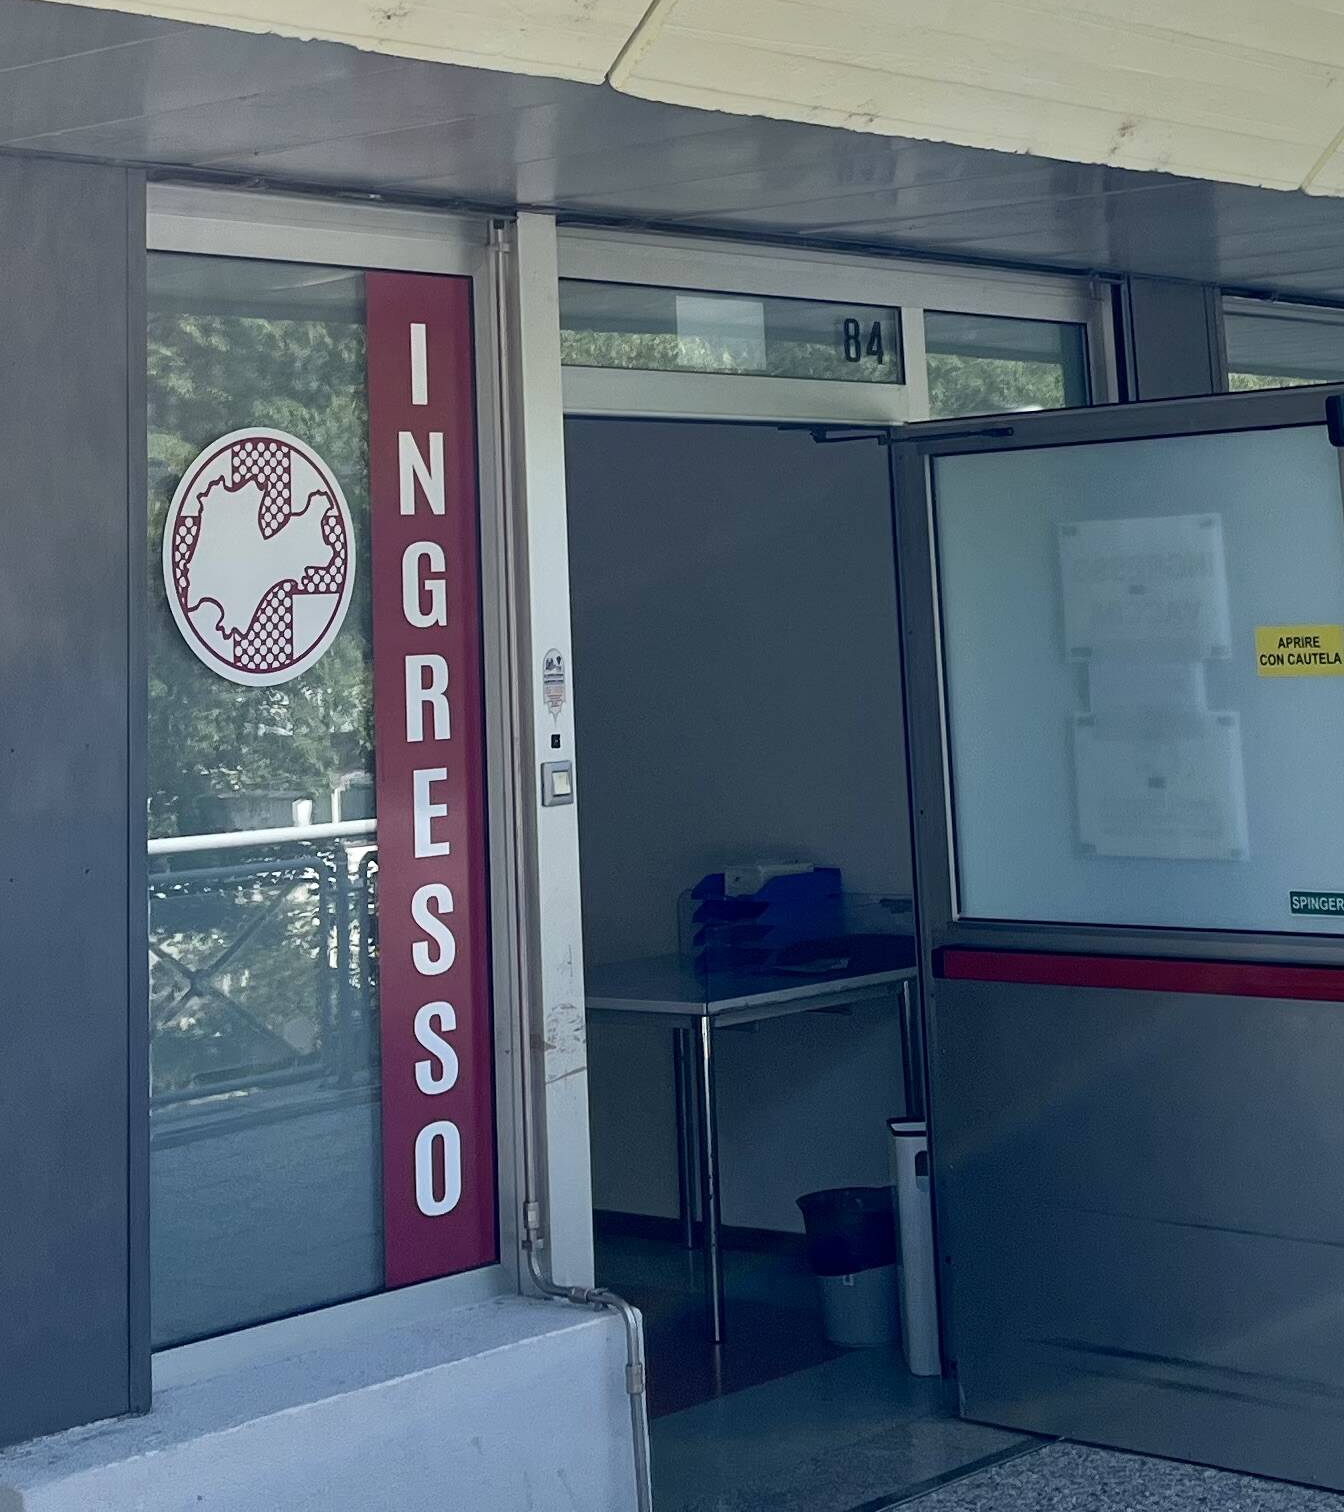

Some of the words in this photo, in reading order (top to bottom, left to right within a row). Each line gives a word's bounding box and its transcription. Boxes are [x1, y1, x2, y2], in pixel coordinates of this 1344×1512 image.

[843, 318, 884, 364] 84
[1277, 636, 1321, 649] APRIRE
[1259, 653, 1285, 666] CON
[1287, 652, 1343, 665] CAUTELA
[398, 323, 462, 1216] INGRESSO
